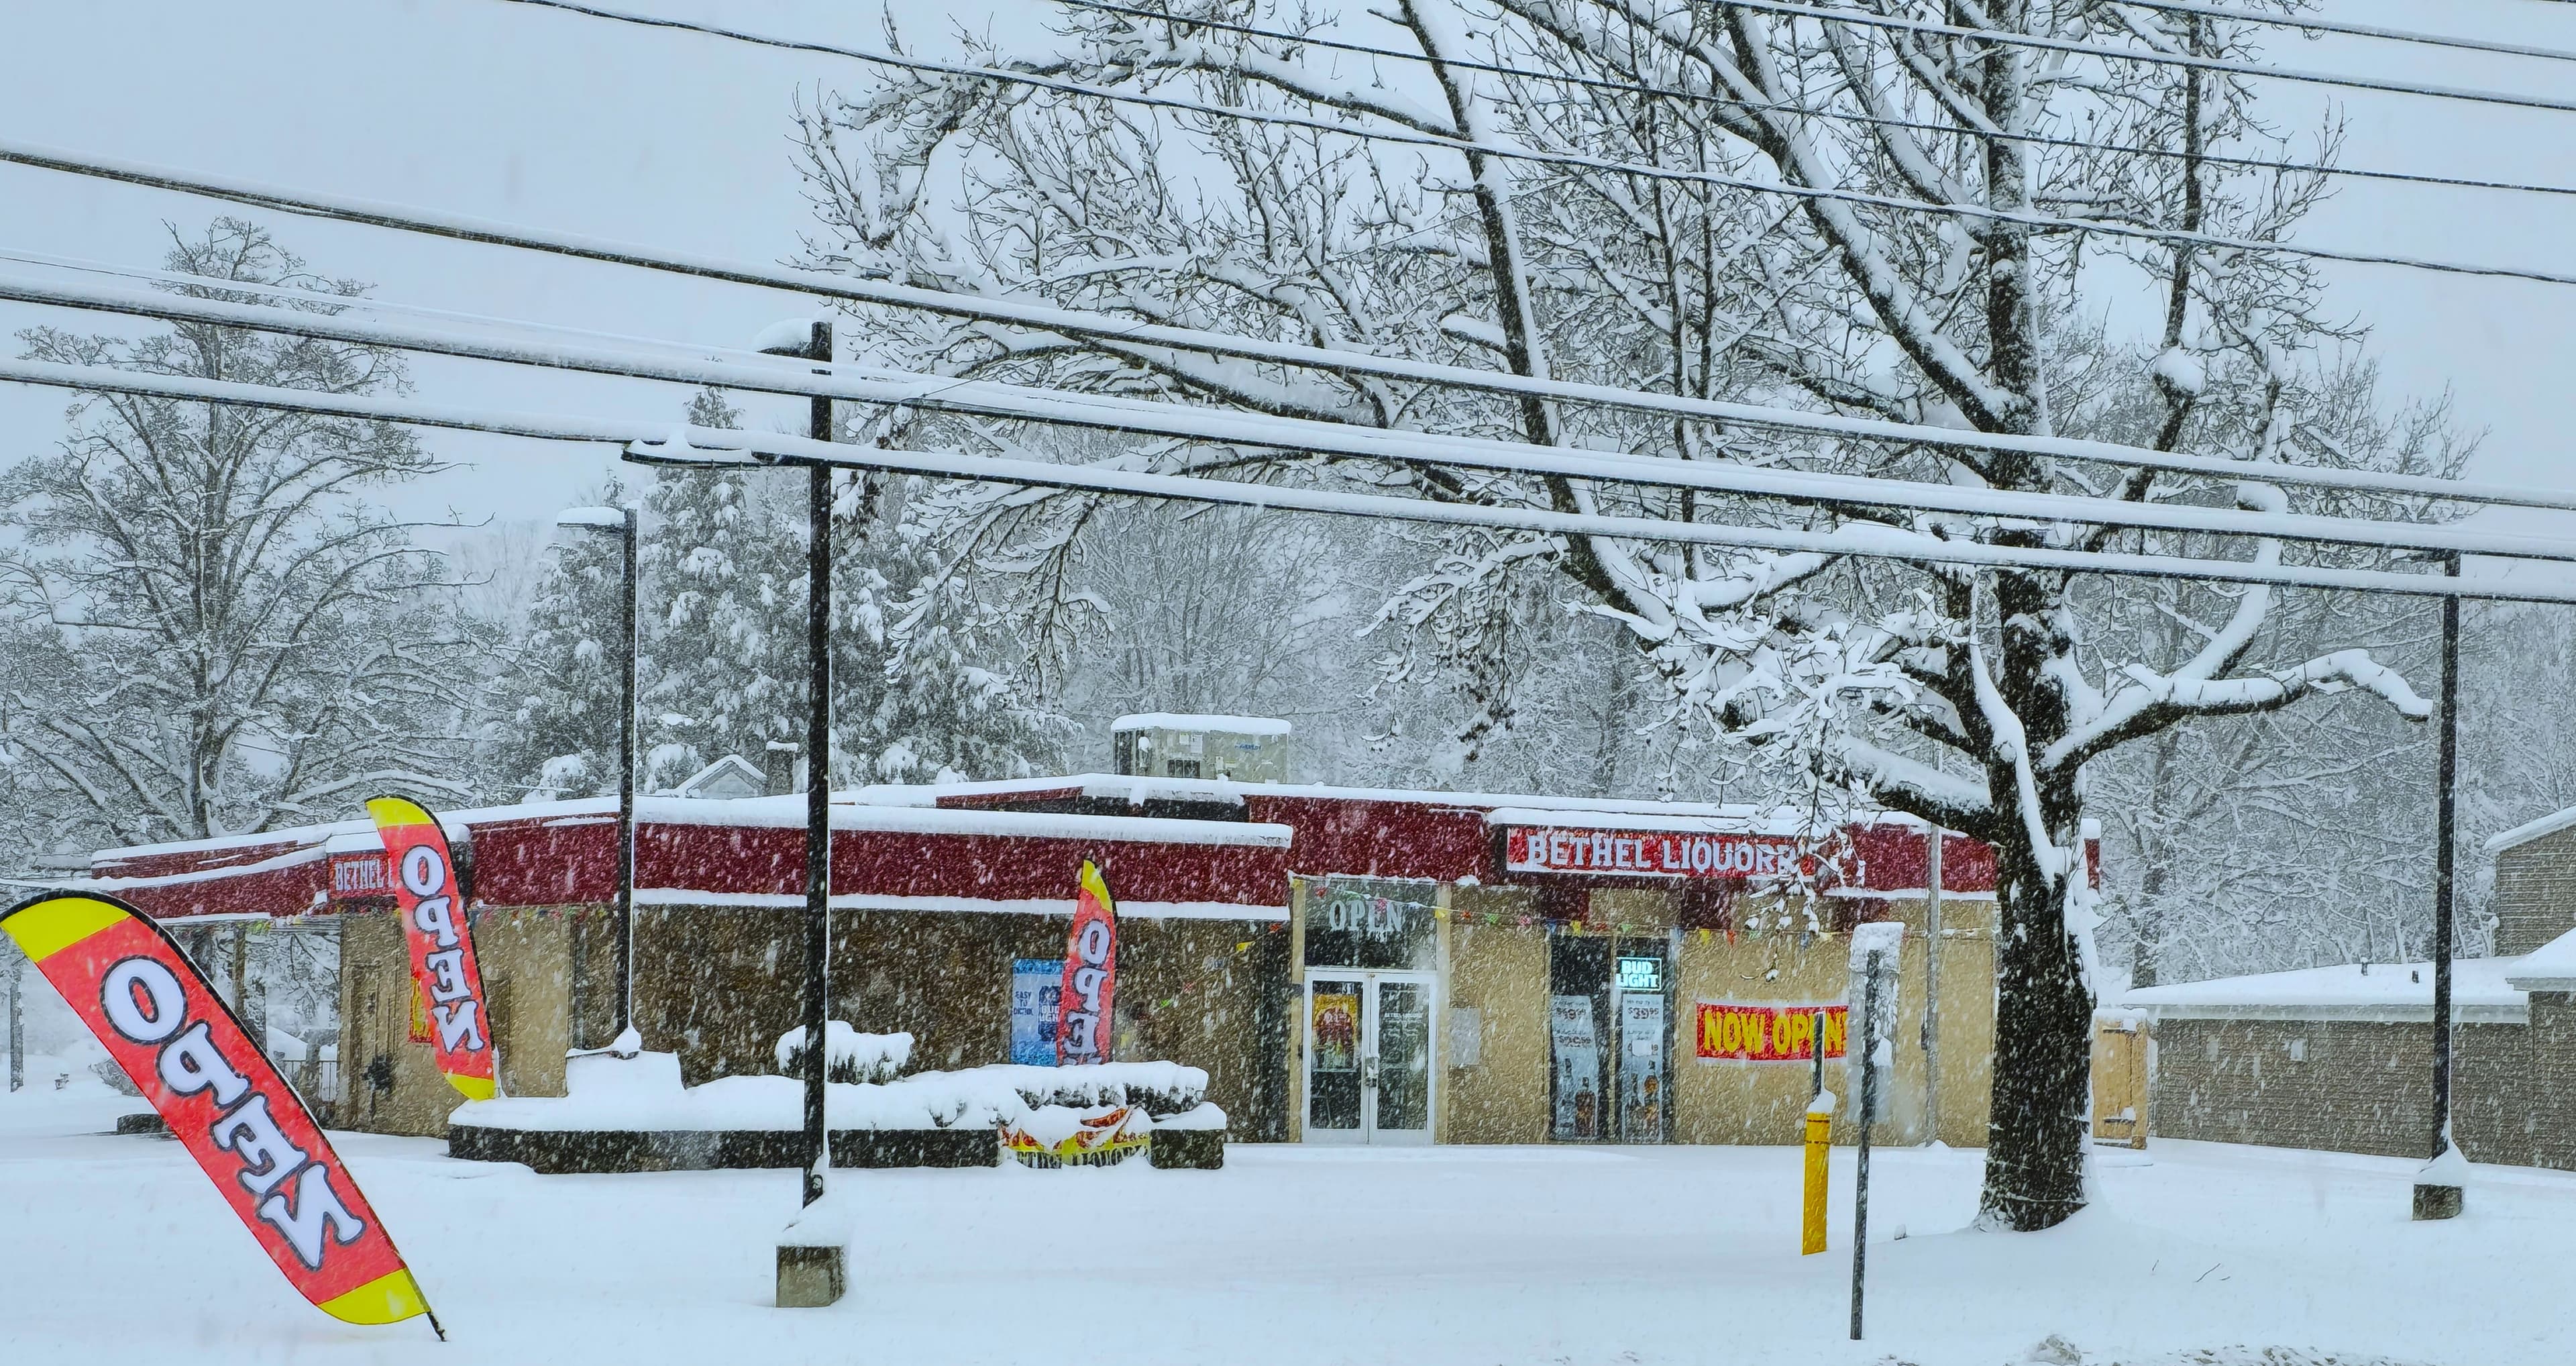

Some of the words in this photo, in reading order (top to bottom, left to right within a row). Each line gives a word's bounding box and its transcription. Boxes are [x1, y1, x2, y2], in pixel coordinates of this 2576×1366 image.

[1527, 835, 1652, 868] BETHEL
[335, 858, 384, 891] BETHEL
[1329, 900, 1403, 932] OPEN
[1615, 974, 1659, 988] LIGHT
[1620, 960, 1653, 974] BUD
[1039, 1014, 1059, 1022] LIGH
[1704, 1010, 1766, 1053] NOW
